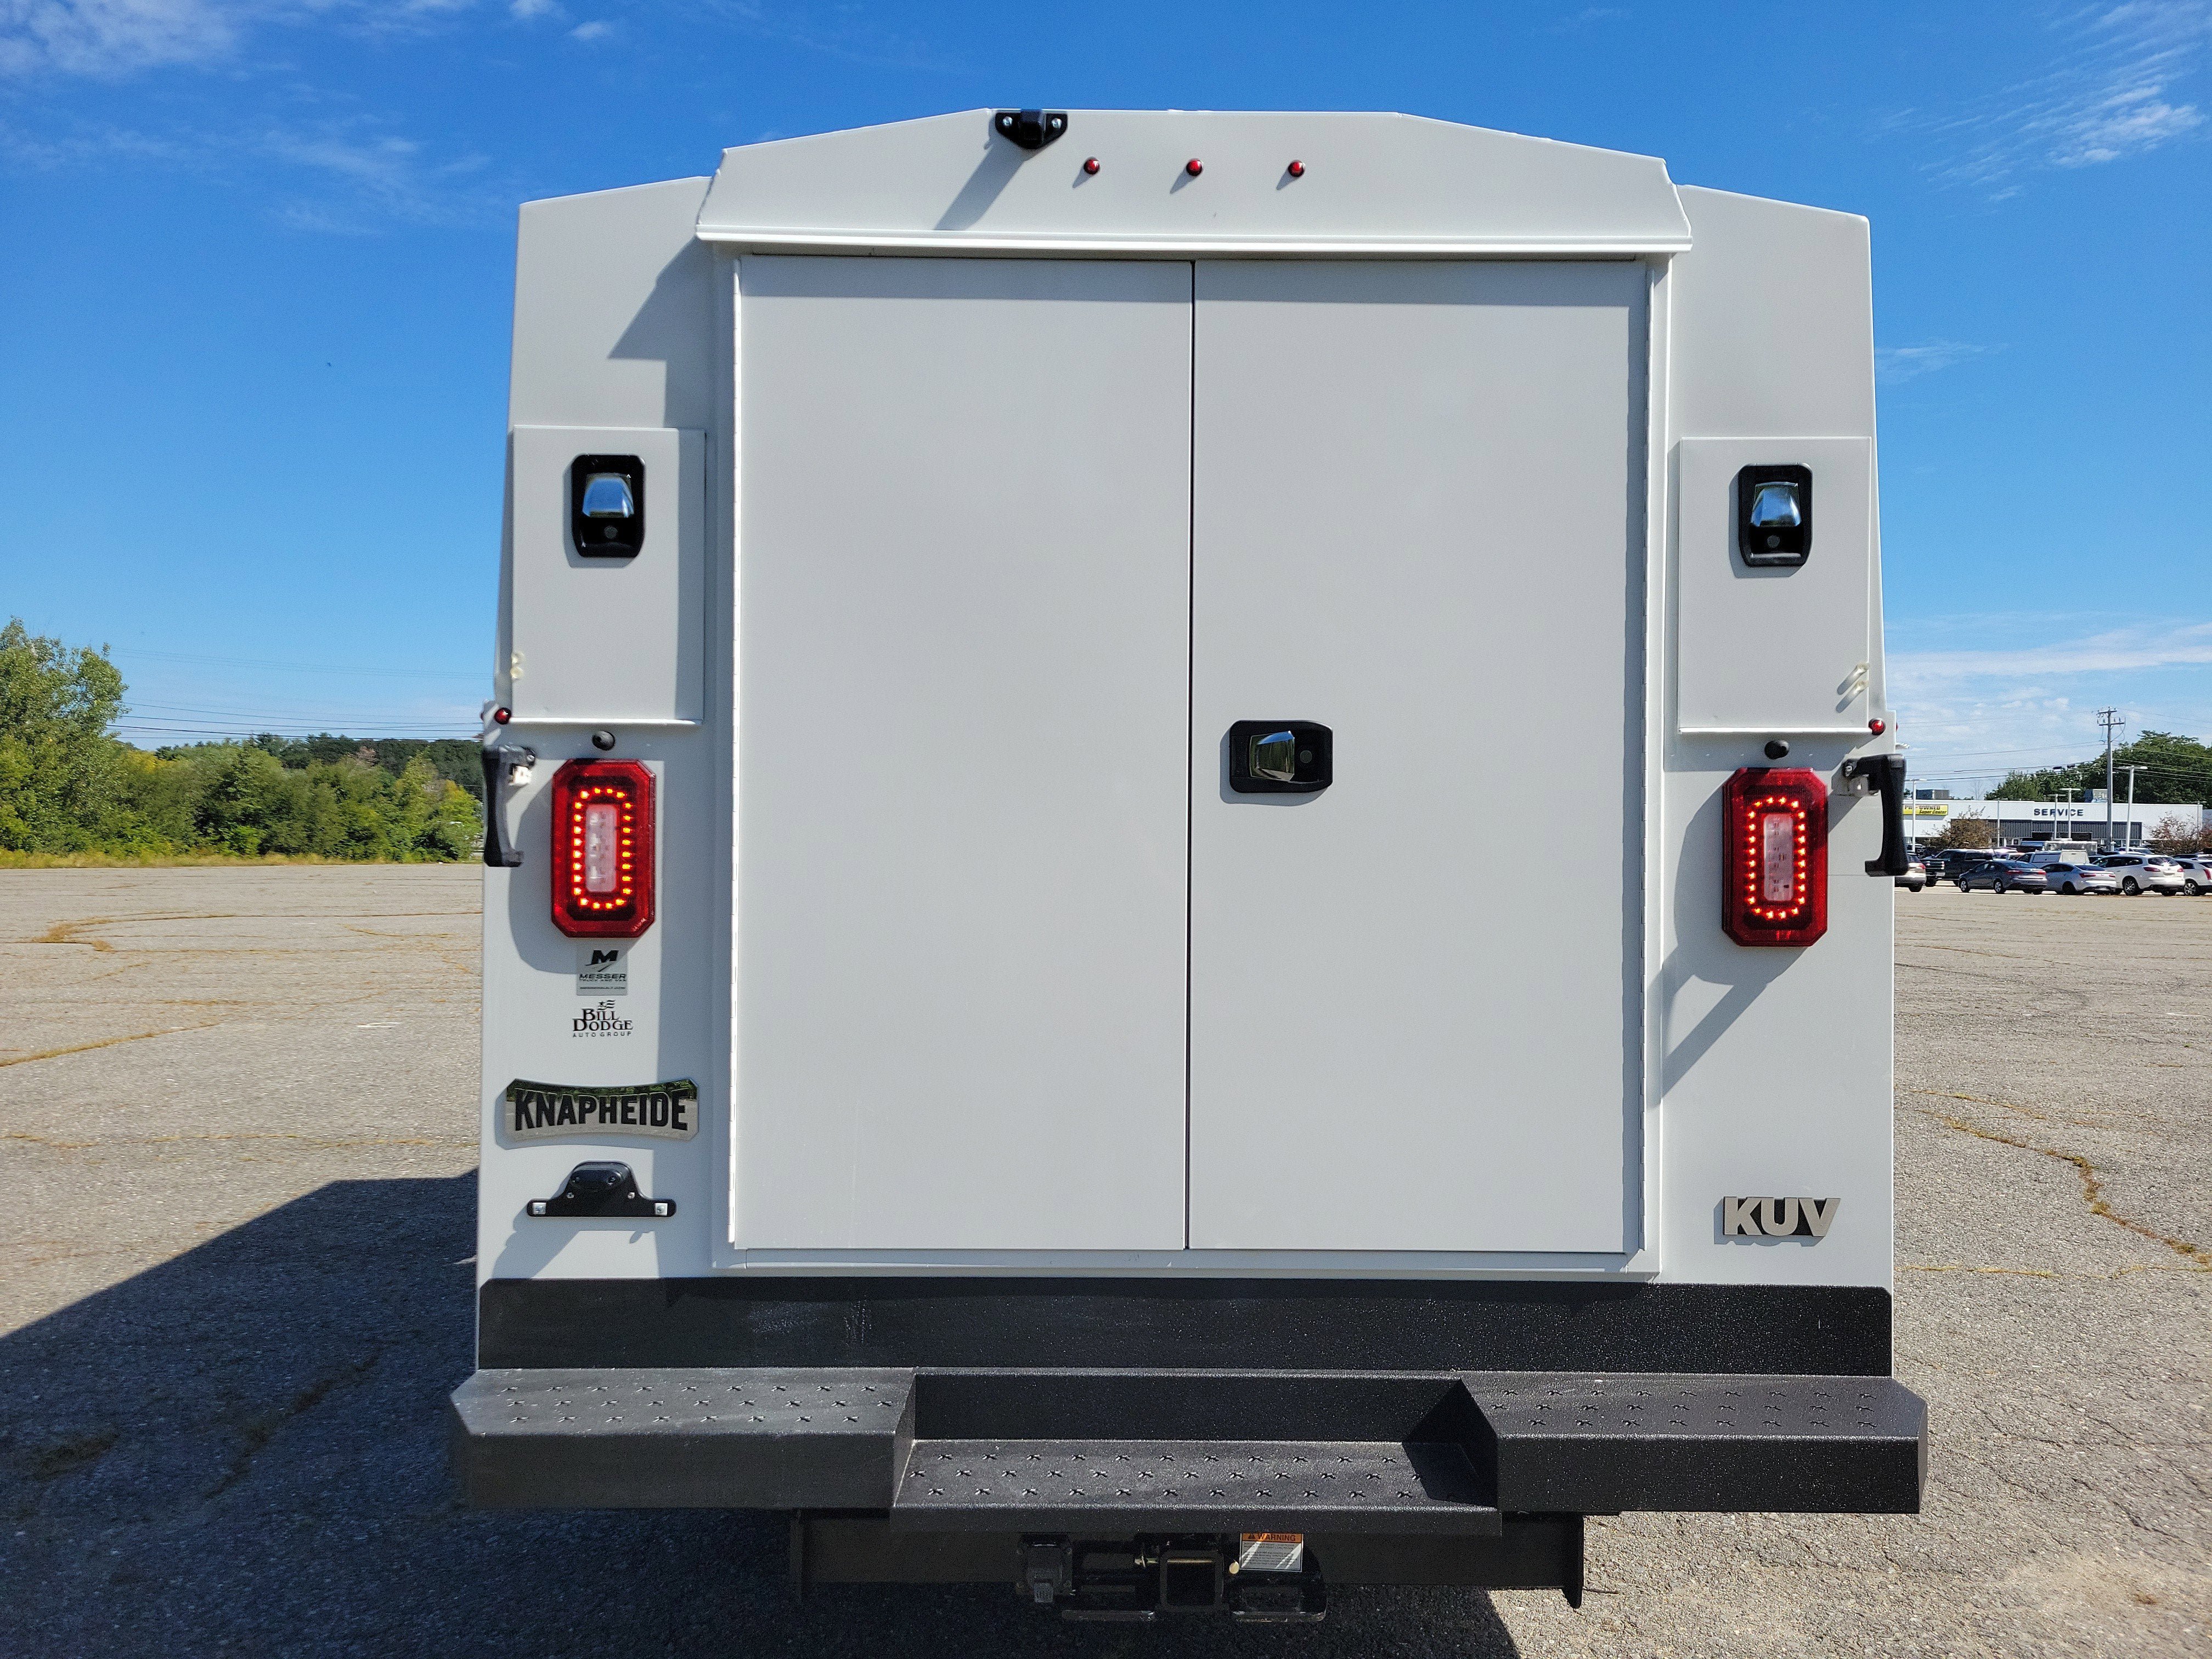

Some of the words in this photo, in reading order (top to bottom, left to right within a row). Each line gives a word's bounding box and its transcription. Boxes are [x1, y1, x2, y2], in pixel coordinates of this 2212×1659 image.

[2034, 808, 2084, 816] SERVICE
[582, 1008, 620, 1021] BILL
[572, 1018, 634, 1031] DODGE
[515, 1087, 689, 1131] KNAPHEIDE
[1723, 1196, 1841, 1237] KUV
[1257, 1533, 1296, 1542] WARNING
